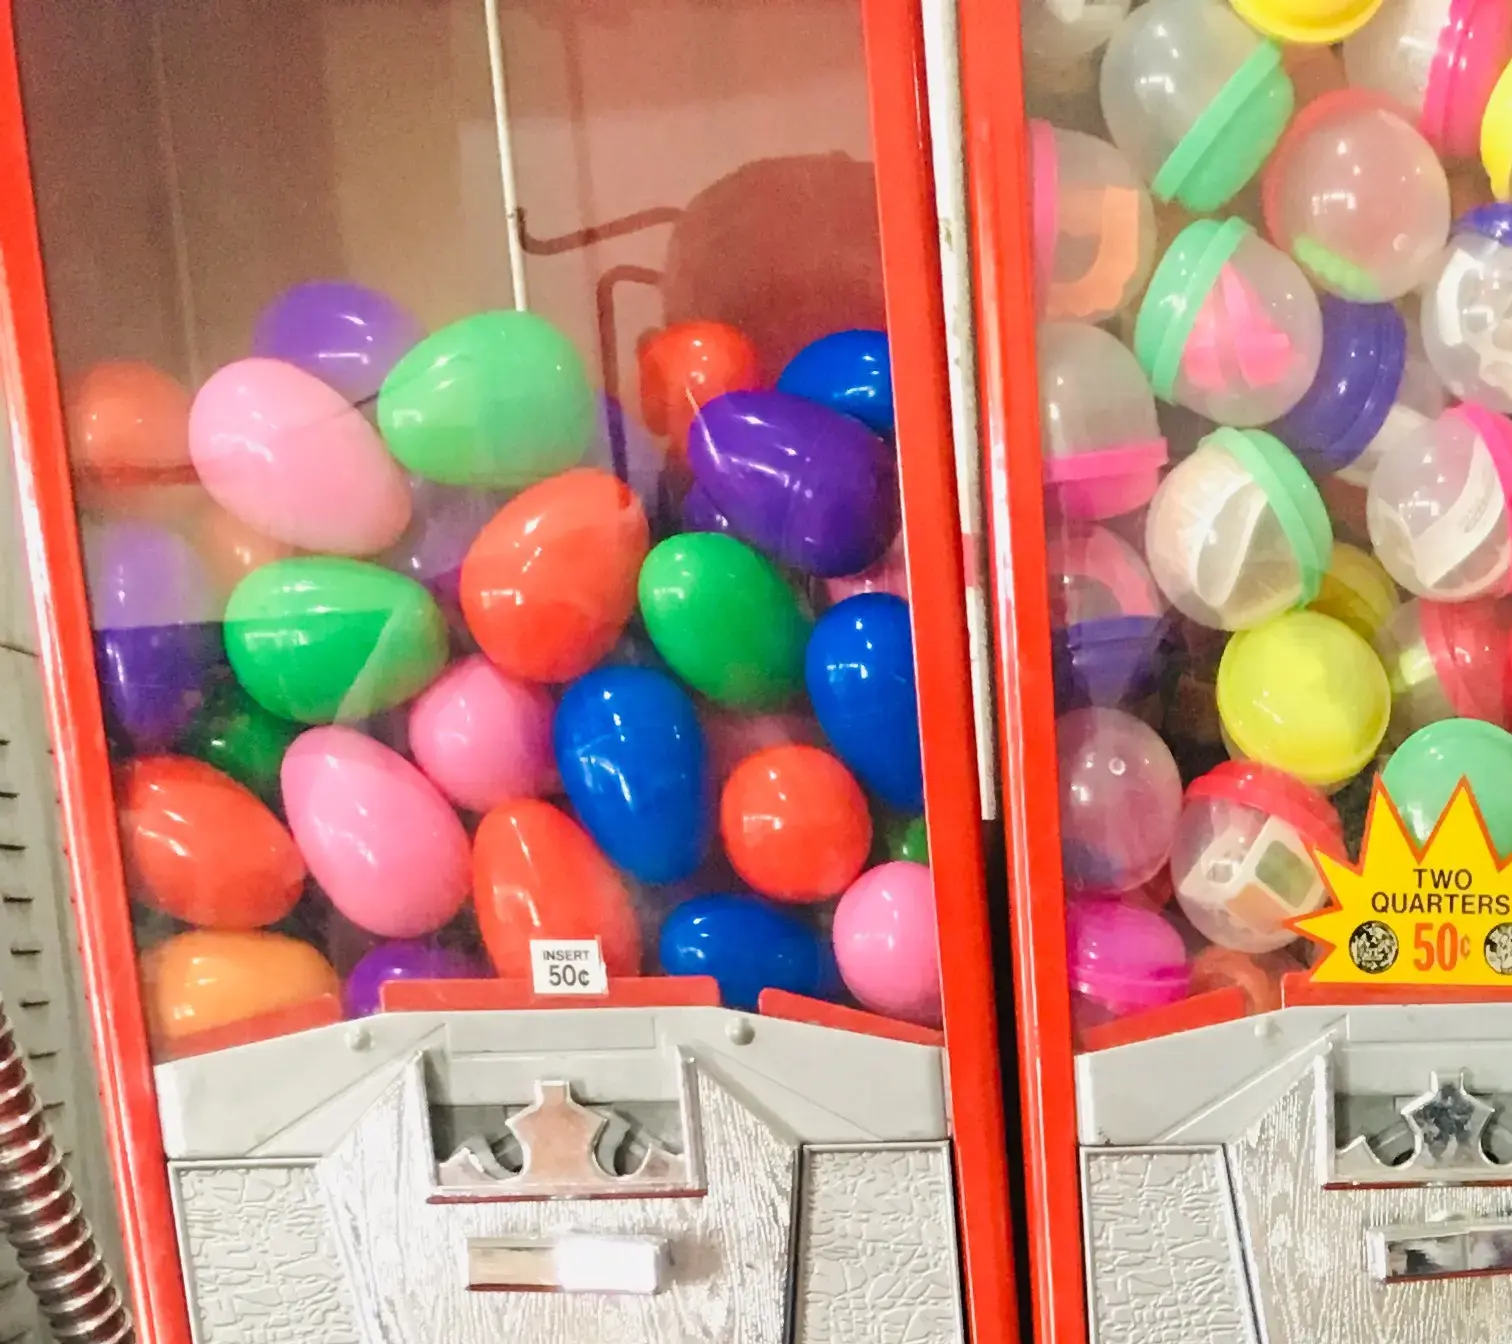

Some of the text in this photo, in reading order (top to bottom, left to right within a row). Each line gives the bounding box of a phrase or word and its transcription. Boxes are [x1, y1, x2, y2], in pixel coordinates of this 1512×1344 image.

[1413, 868, 1472, 891] TWO
[1371, 892, 1511, 916] QUARTERS
[542, 950, 590, 961] INSERT
[1413, 922, 1472, 972] 50¢
[549, 964, 590, 987] 50¢
